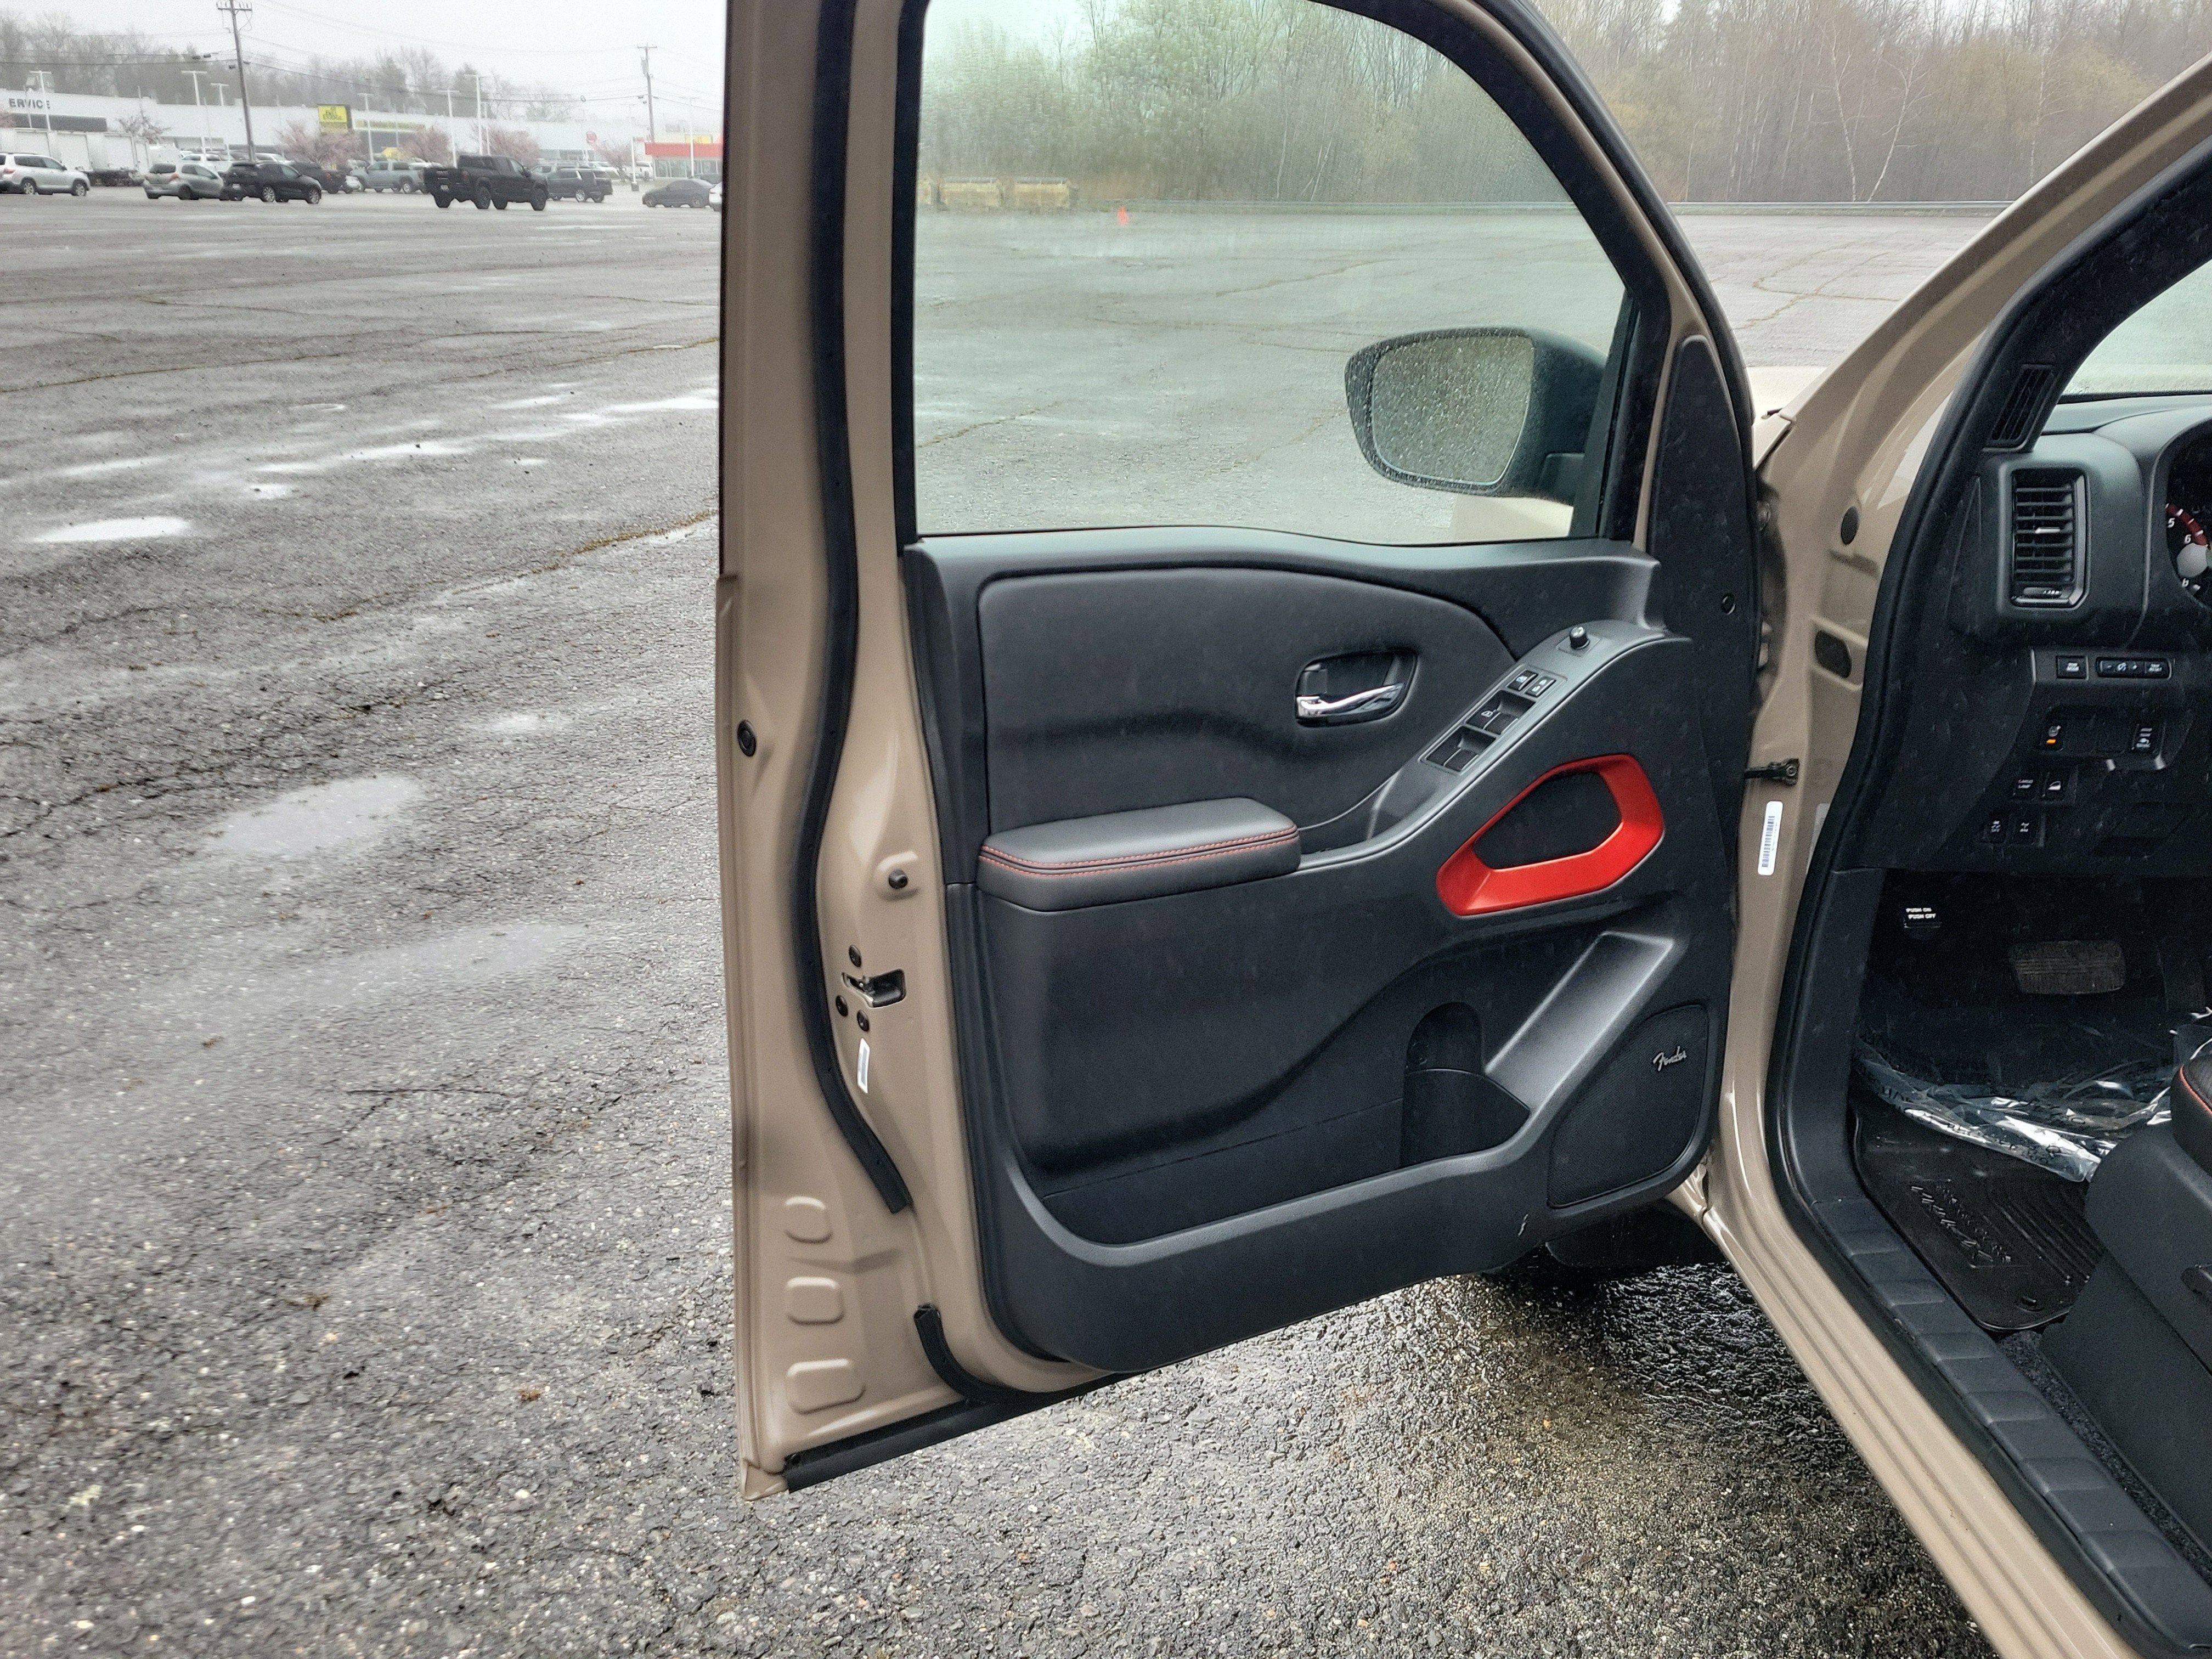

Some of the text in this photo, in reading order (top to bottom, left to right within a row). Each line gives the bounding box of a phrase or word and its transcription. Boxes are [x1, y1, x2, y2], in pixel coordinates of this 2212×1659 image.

[2168, 518, 2175, 528] 5
[2184, 534, 2192, 544] 6
[1652, 1045, 1688, 1072] Fender
